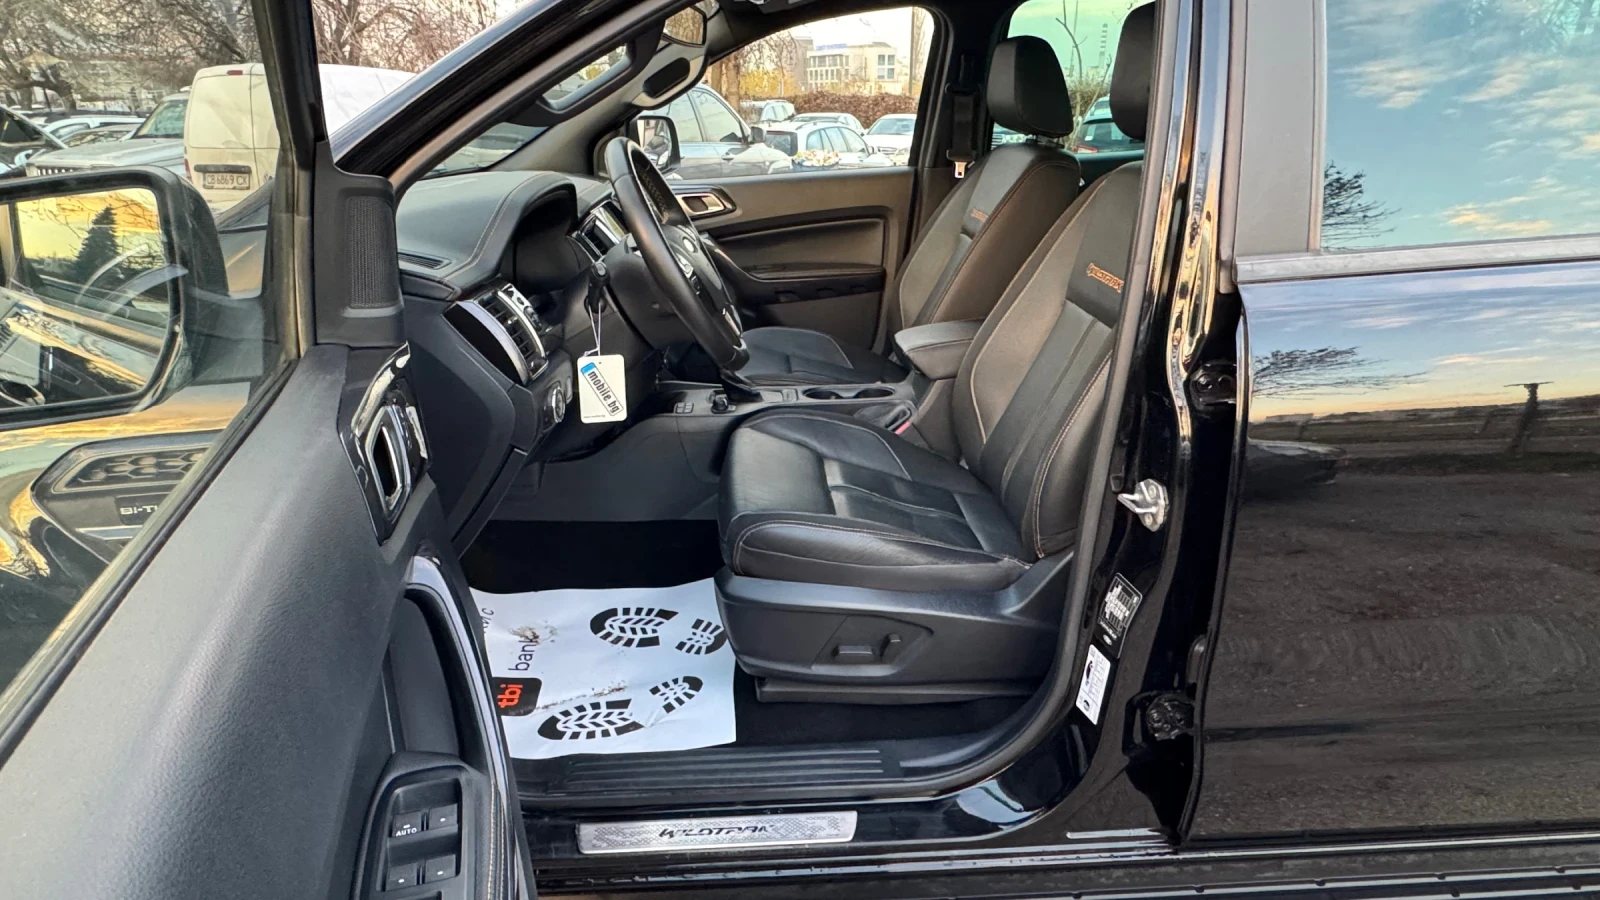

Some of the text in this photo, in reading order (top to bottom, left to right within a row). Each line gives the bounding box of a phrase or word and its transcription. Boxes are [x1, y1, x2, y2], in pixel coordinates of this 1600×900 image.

[588, 371, 620, 413] mobile.bg
[497, 684, 523, 708] tbi
[395, 827, 418, 837] AUTO
